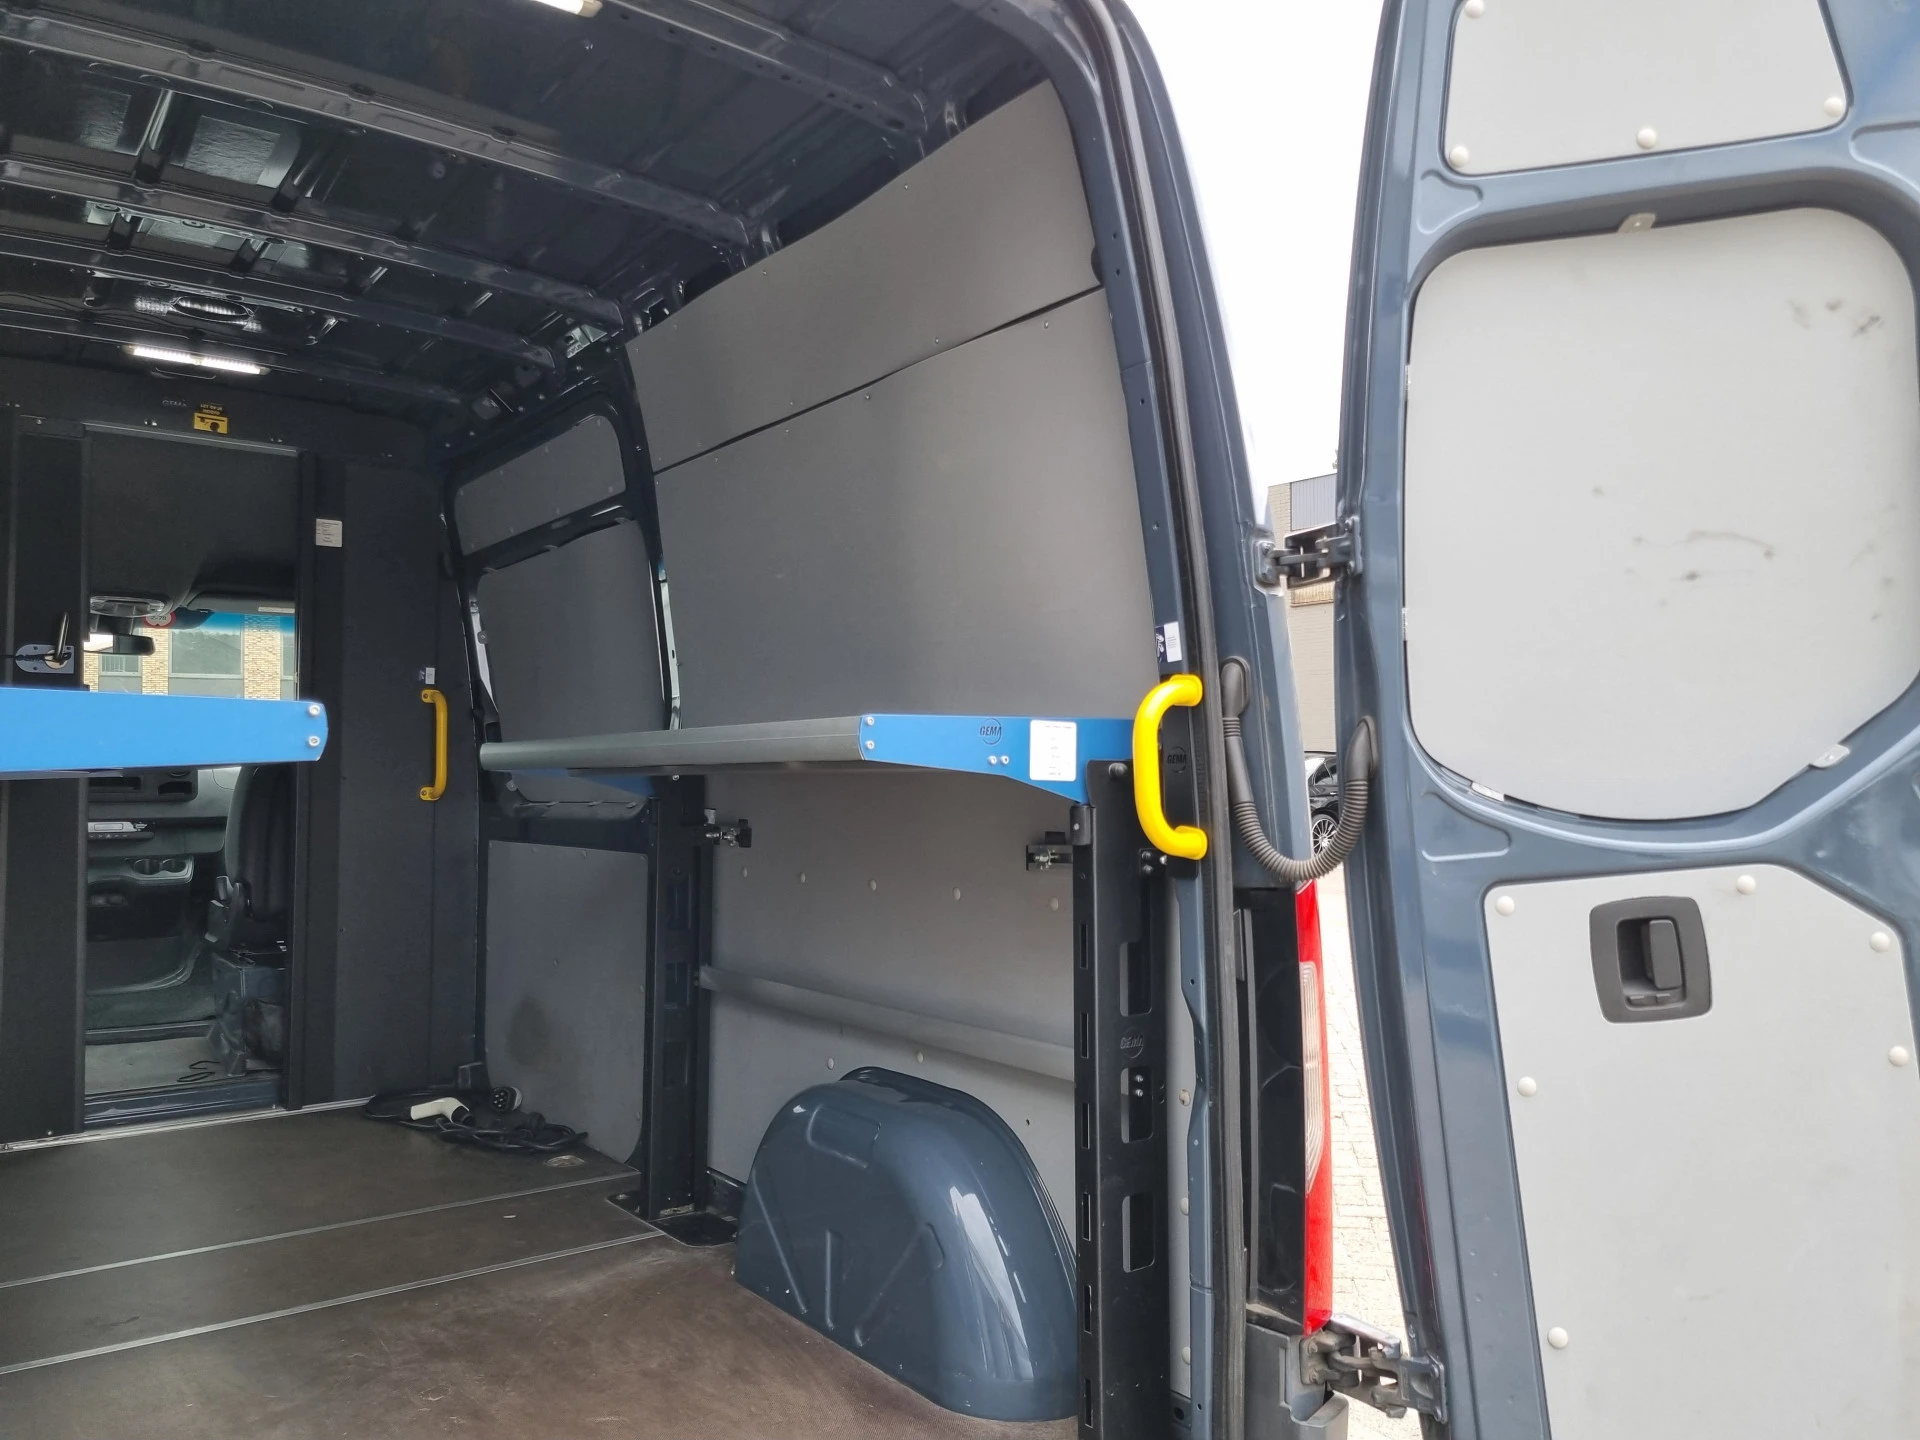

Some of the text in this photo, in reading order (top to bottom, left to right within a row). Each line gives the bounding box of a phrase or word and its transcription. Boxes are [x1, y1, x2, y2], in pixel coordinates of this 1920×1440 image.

[979, 725, 1002, 736] GEMA
[1167, 754, 1187, 764] GEMA
[1120, 1034, 1144, 1049] GEMA
